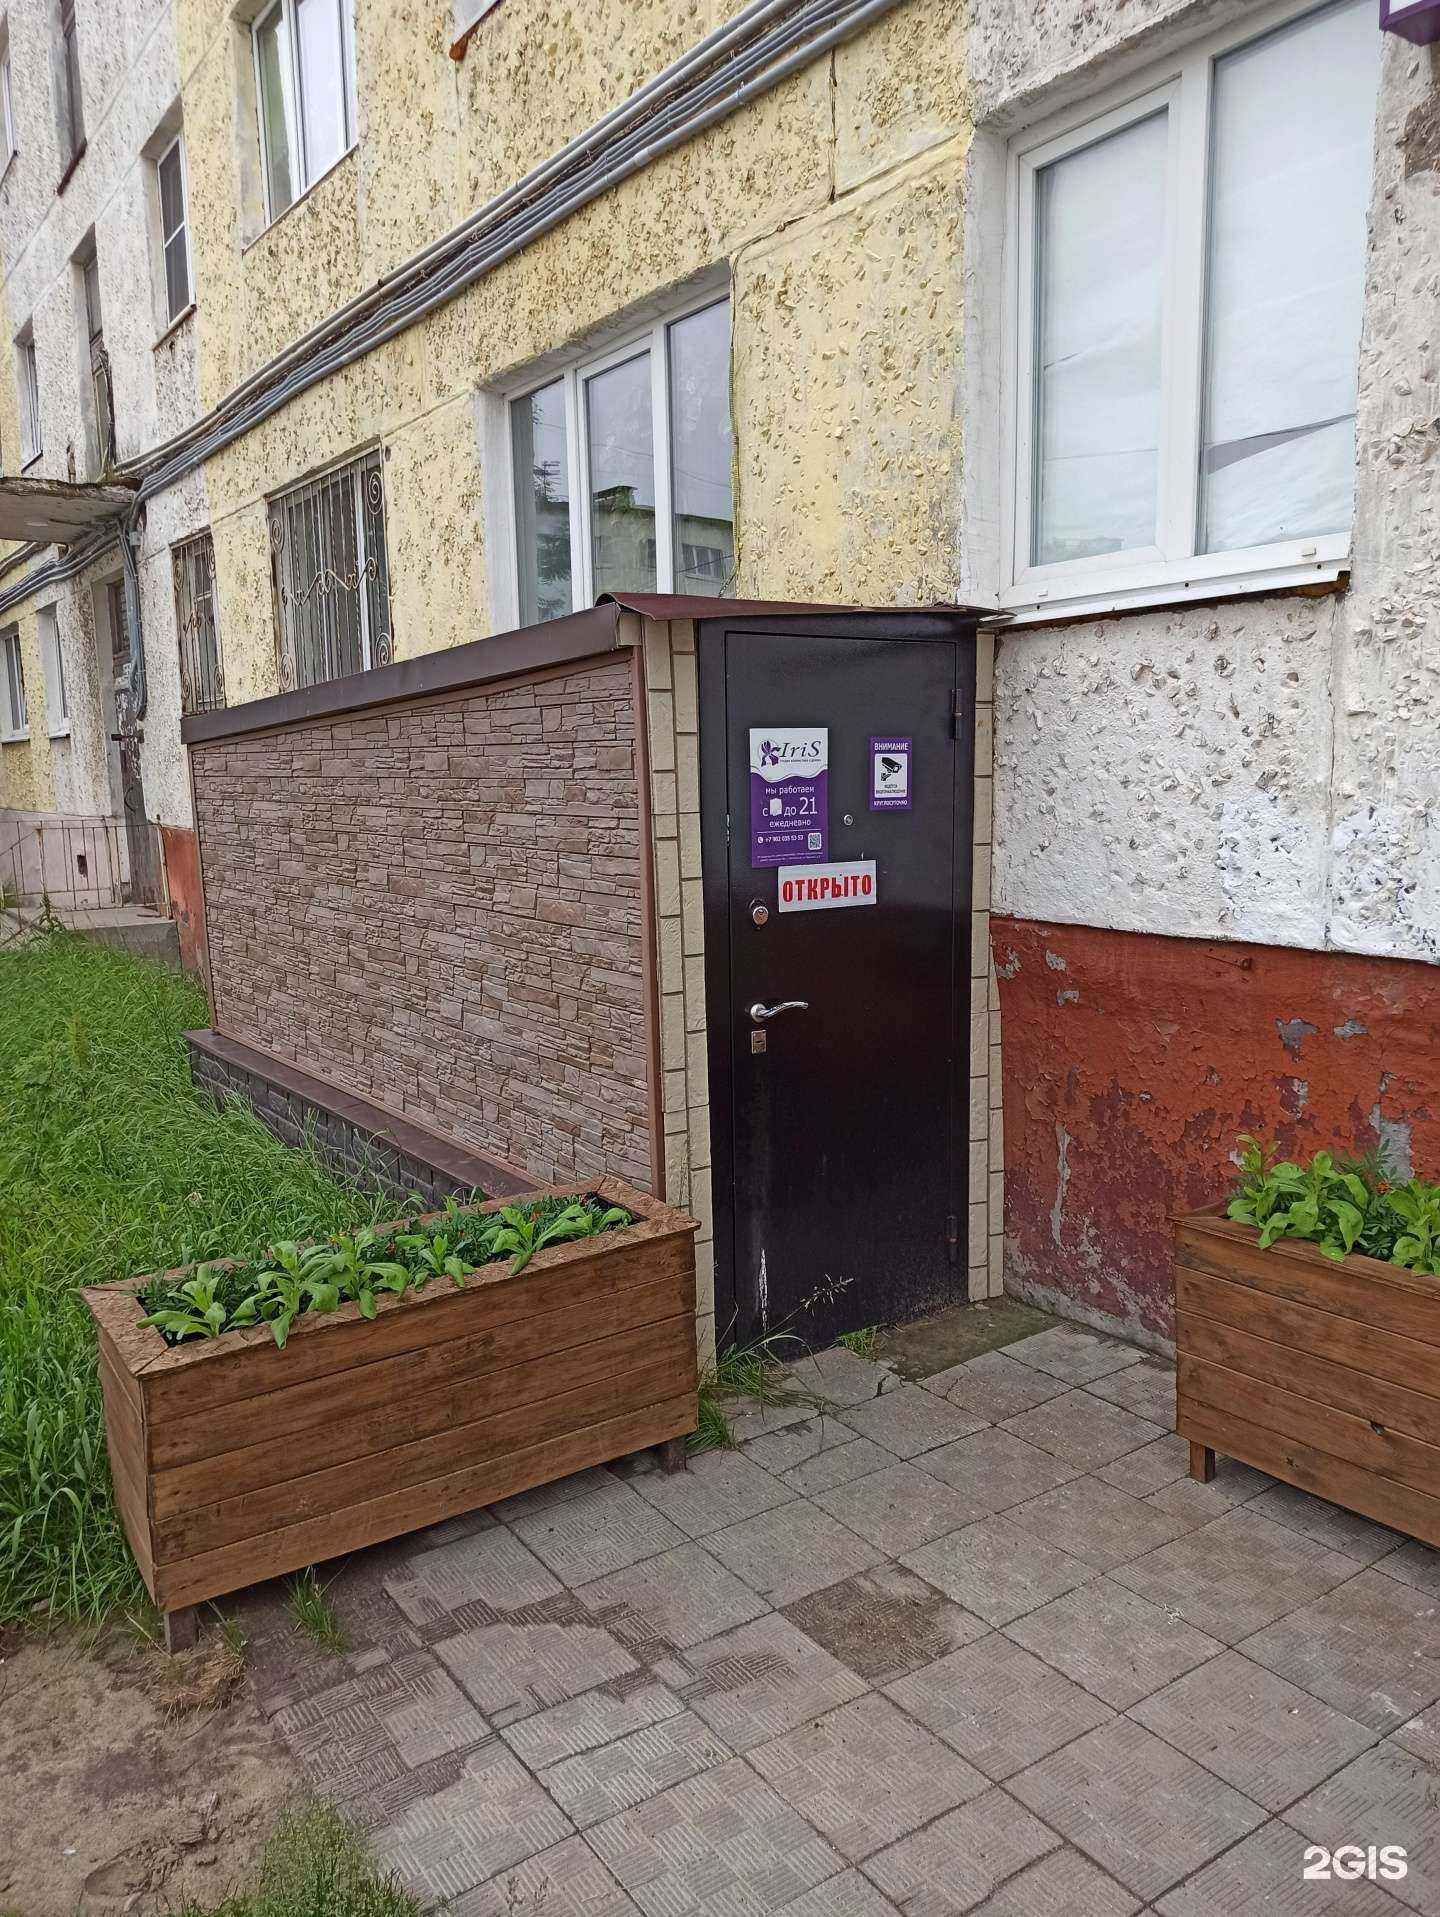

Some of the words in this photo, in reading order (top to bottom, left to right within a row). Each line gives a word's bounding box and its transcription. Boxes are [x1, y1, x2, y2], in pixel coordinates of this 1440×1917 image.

[779, 740, 821, 757] IriS
[874, 742, 909, 751] ВНИМАНИЕ
[779, 784, 815, 796] работаем
[762, 807, 769, 817] с
[783, 806, 797, 817] до
[799, 796, 818, 815] 21
[769, 818, 812, 829] ежедневно
[782, 873, 873, 902] ОТКРЫТО
